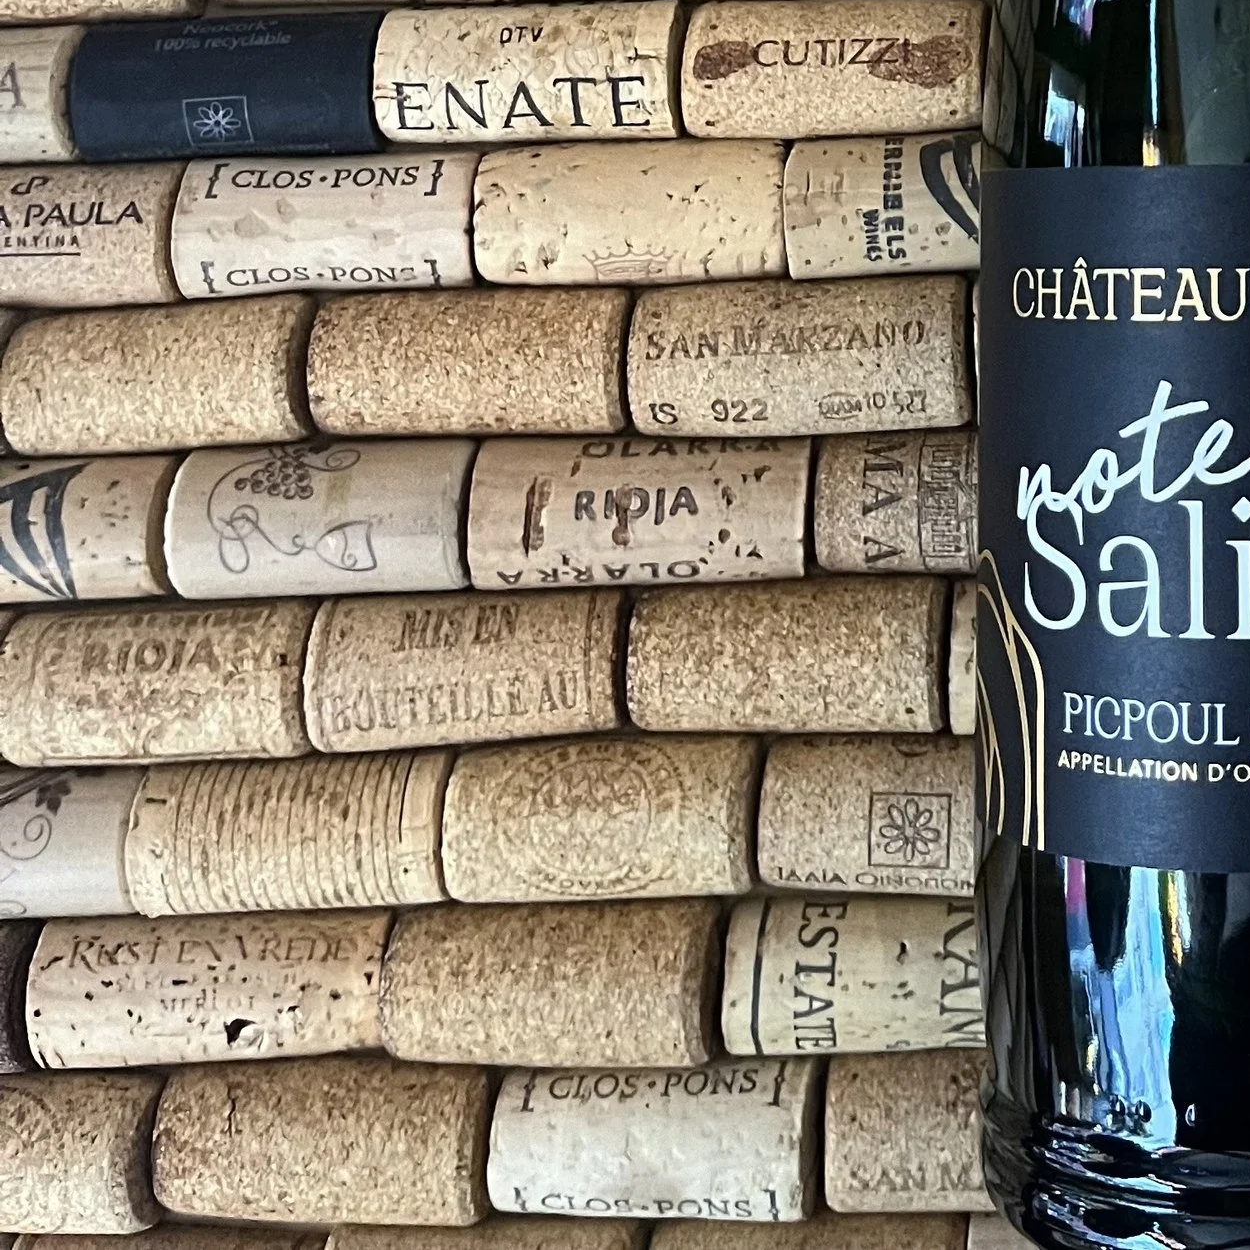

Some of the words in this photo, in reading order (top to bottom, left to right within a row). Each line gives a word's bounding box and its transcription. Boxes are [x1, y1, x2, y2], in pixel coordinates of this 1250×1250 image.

[392, 76, 651, 132] ENATE
[24, 200, 144, 228] PAULA
[1012, 256, 1250, 322] CHÂTEAU
[711, 399, 769, 423] 922
[1062, 691, 1240, 746] PICPOUL
[1057, 749, 1198, 782] APPELLATION
[793, 901, 850, 1050] ESTATE
